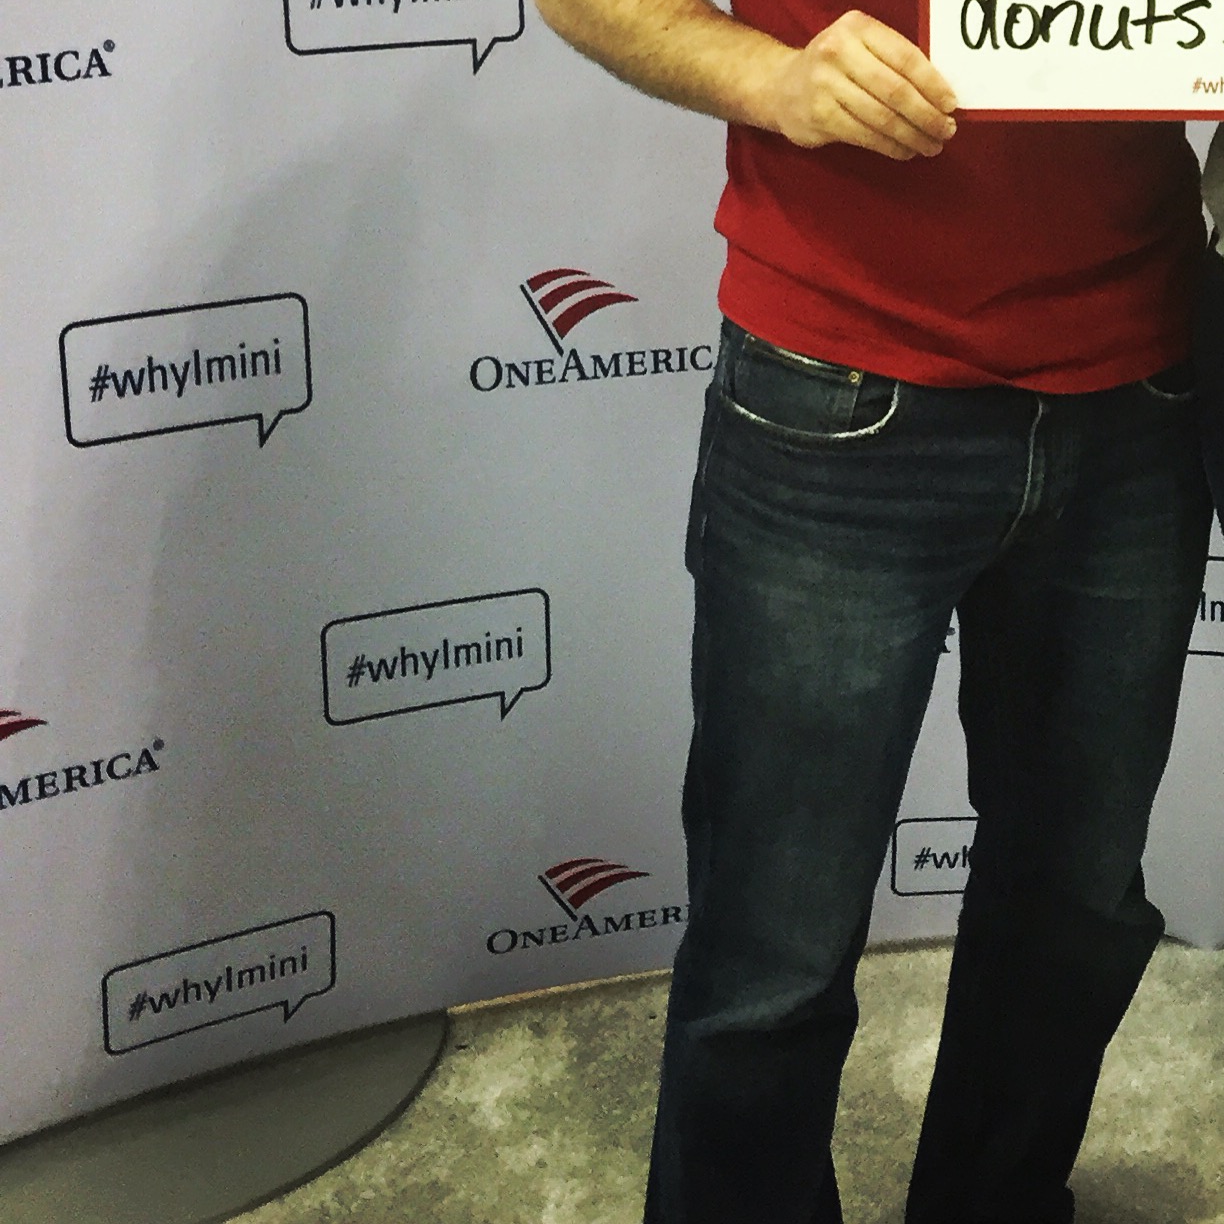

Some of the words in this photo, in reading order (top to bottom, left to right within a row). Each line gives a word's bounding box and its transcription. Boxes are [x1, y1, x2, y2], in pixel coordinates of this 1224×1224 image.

[89, 337, 281, 403] #whyImini
[346, 625, 524, 688] #whyImini
[128, 945, 310, 1022] #whyImini
